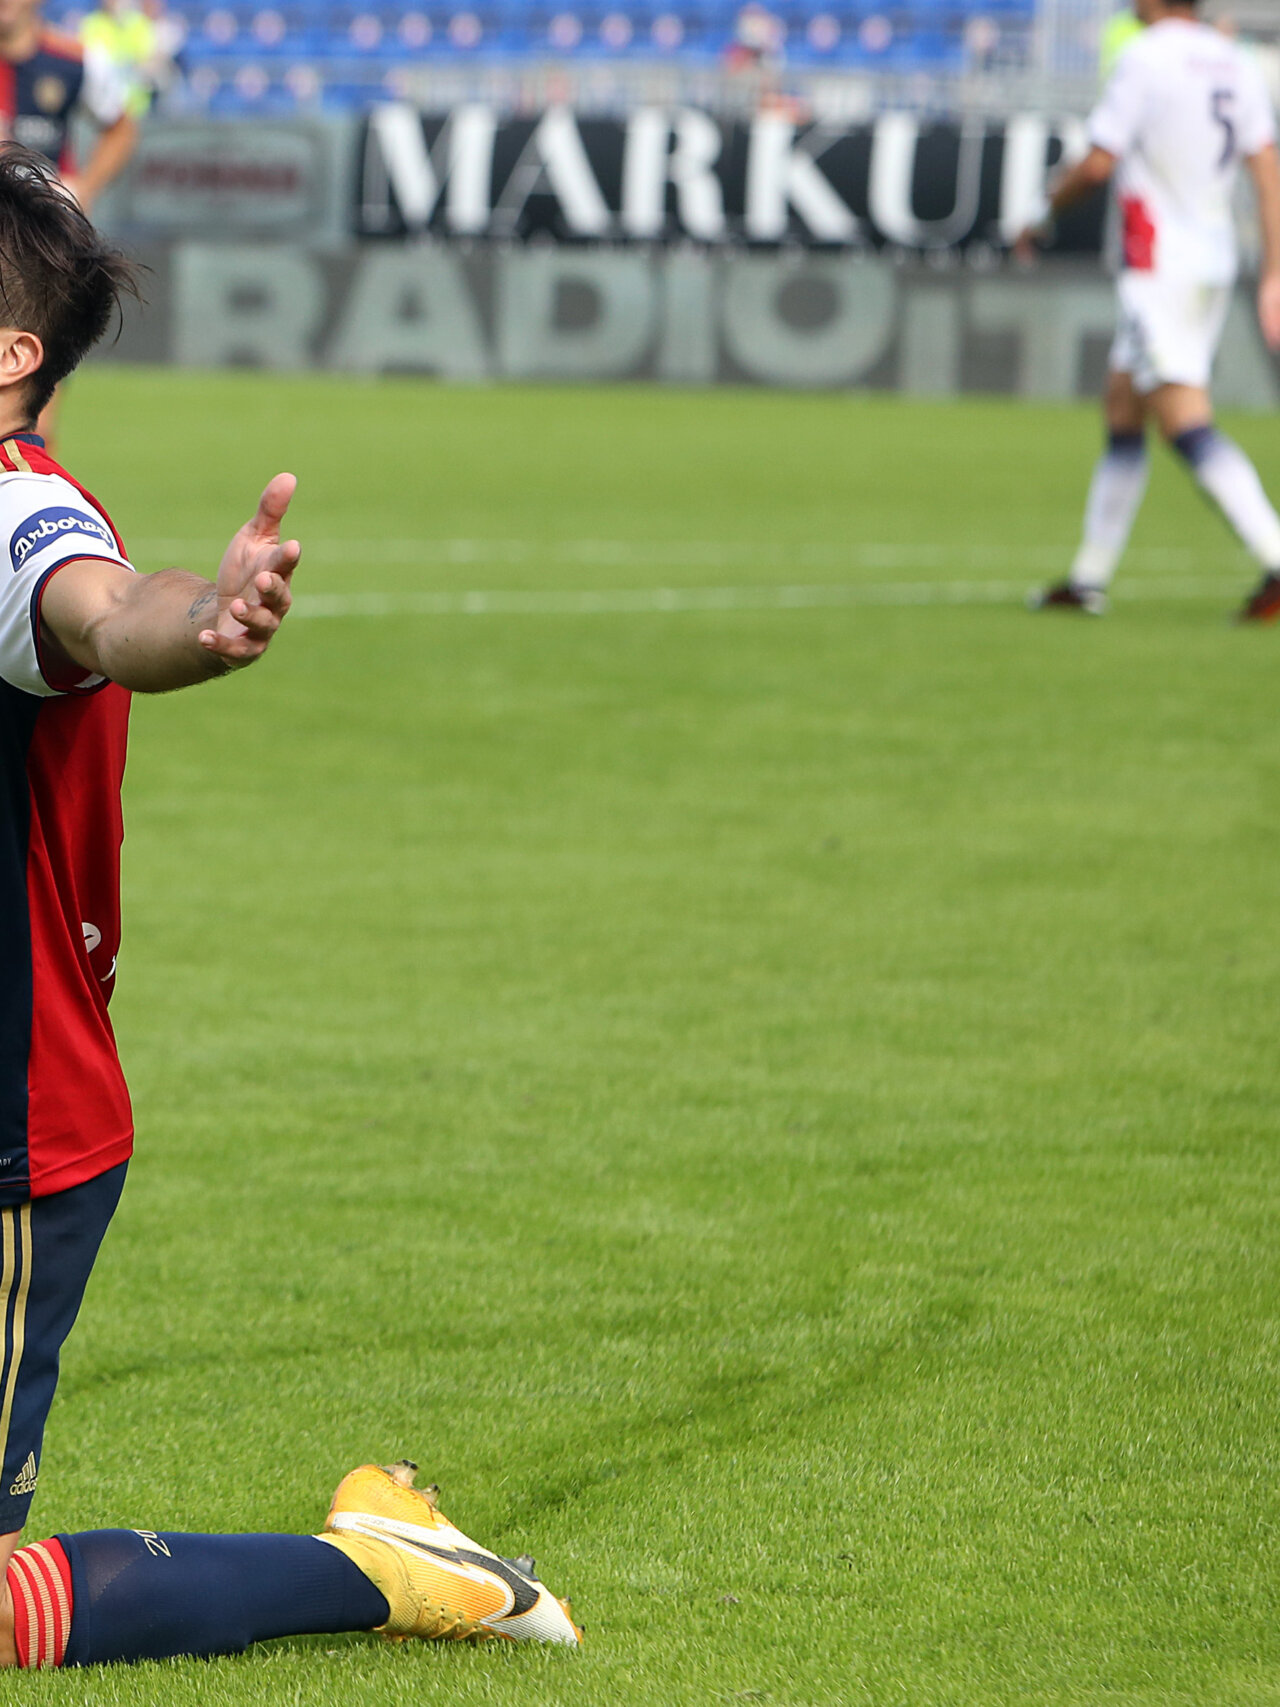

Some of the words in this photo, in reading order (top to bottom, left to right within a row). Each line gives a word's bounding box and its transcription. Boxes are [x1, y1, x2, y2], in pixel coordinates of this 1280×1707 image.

[1211, 88, 1236, 170] 5
[360, 99, 1098, 248] MARKUP
[14, 516, 112, 566] Arborea
